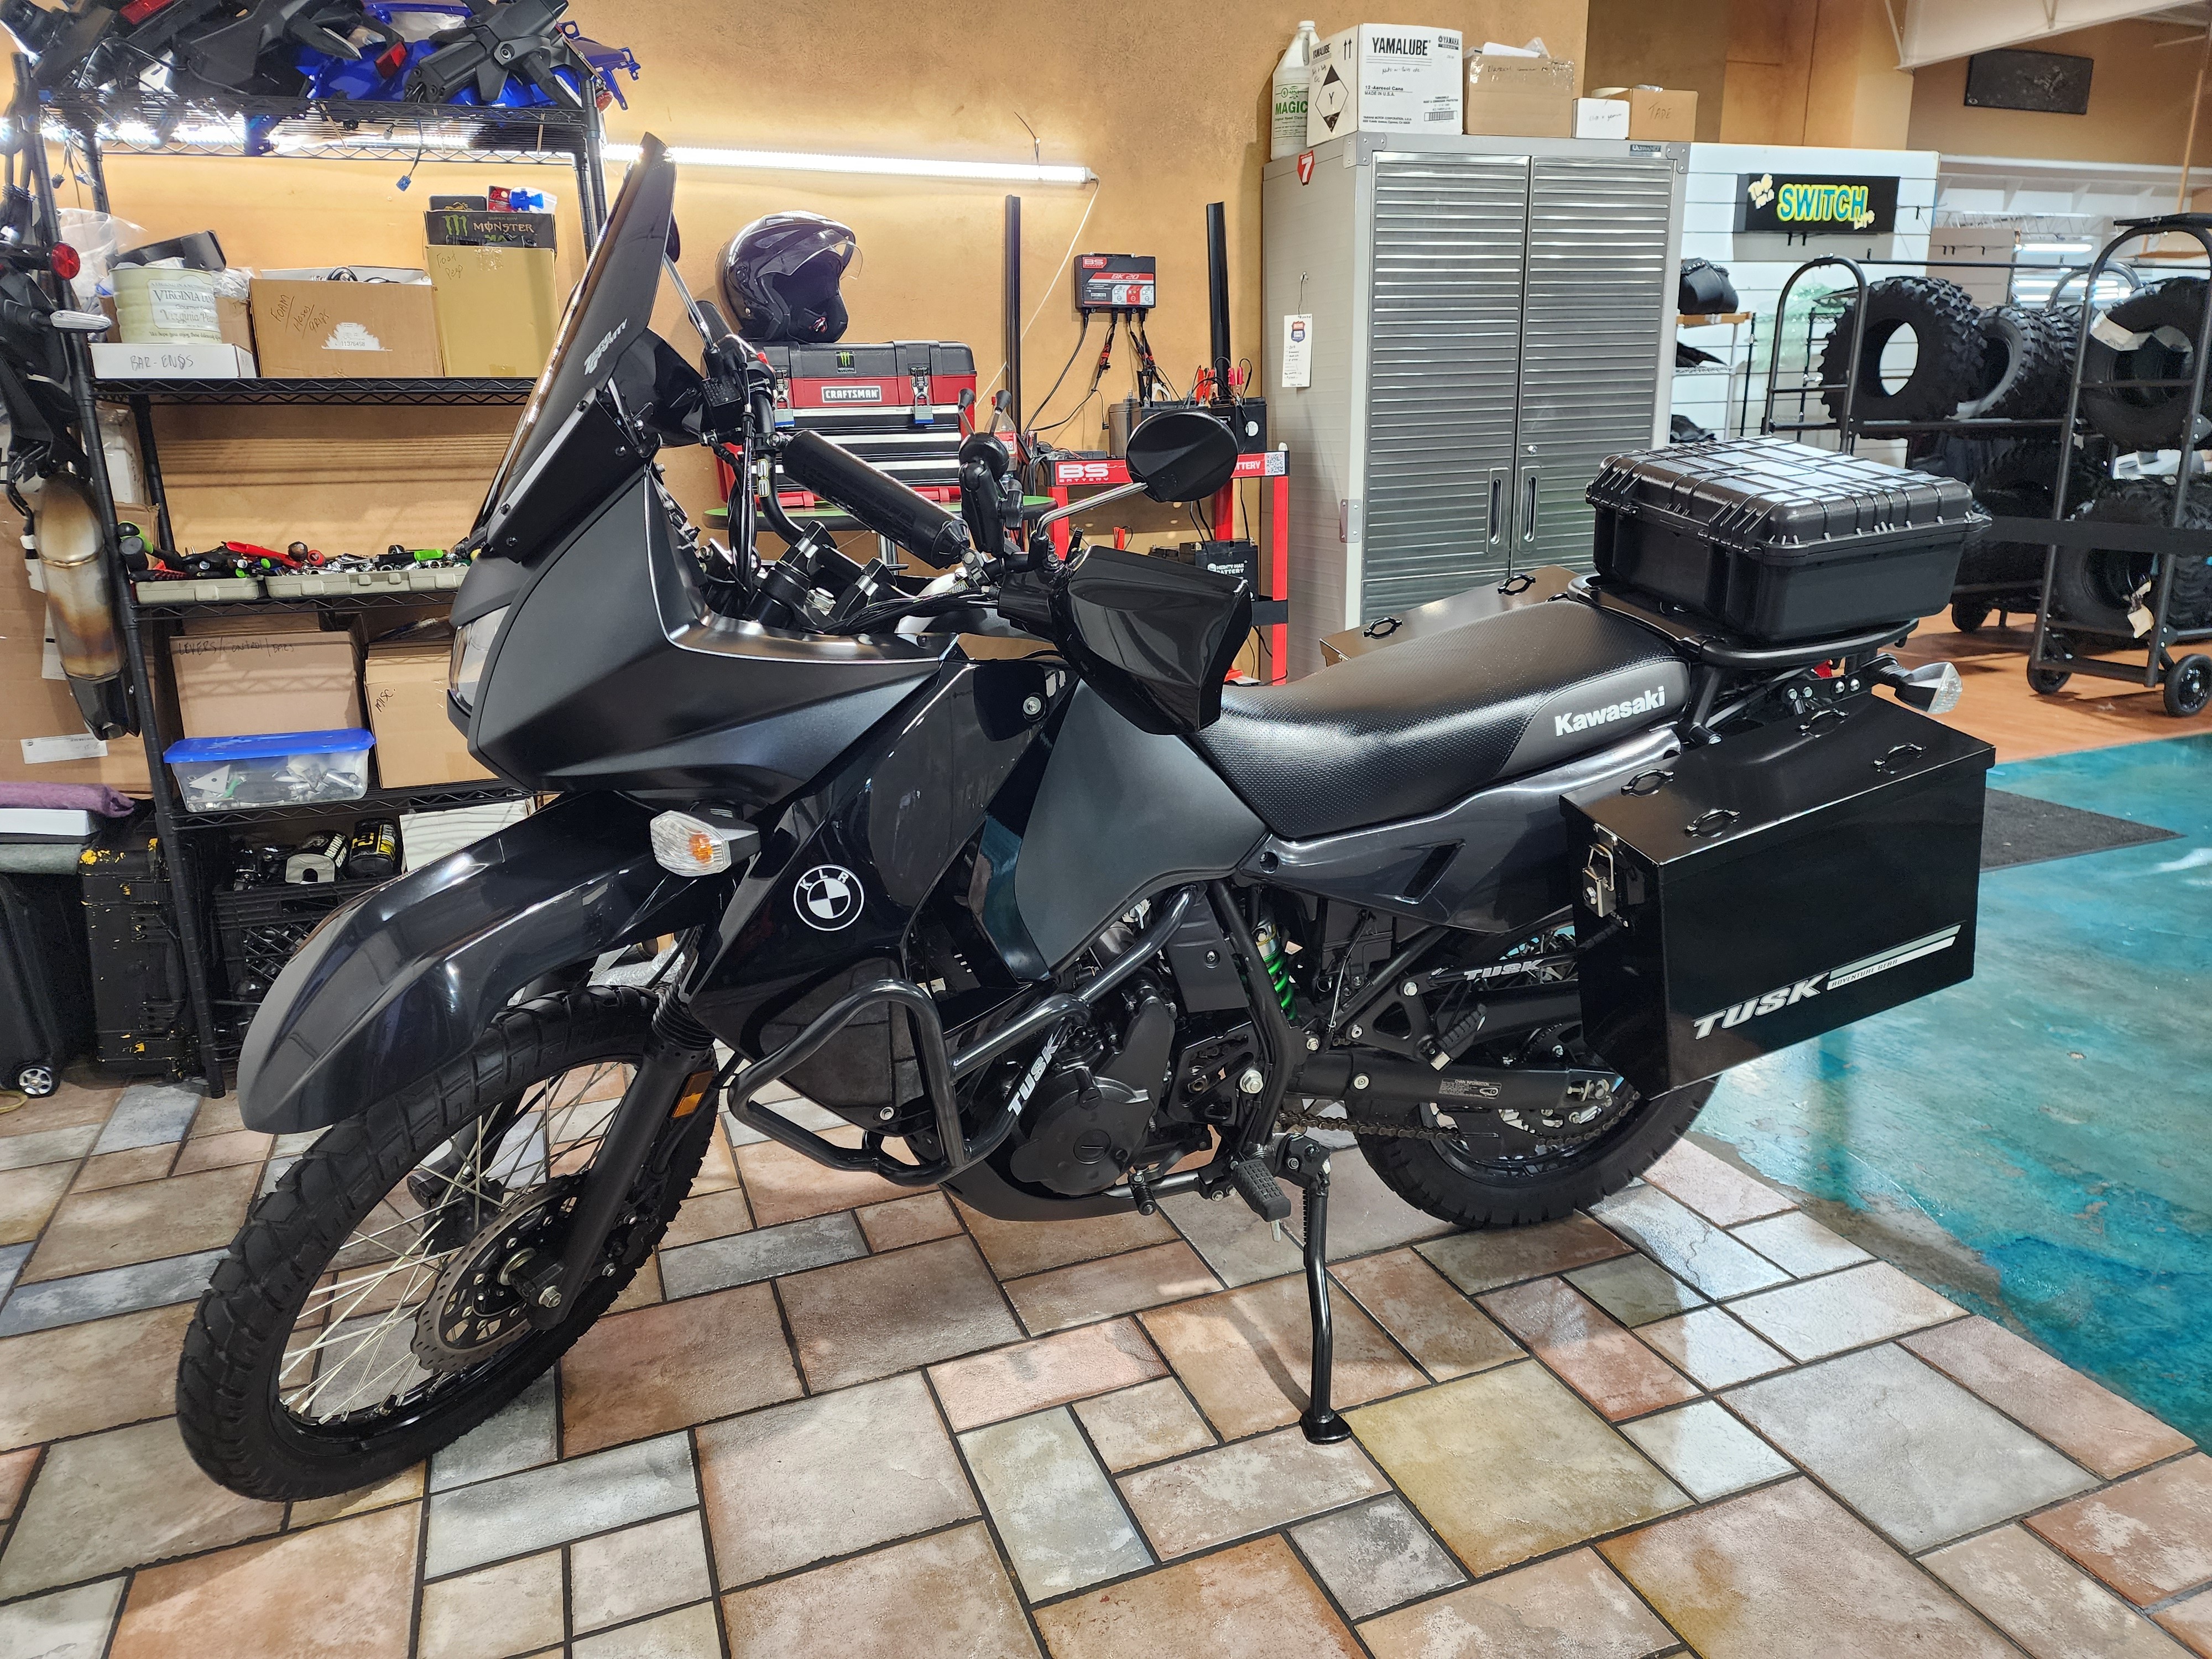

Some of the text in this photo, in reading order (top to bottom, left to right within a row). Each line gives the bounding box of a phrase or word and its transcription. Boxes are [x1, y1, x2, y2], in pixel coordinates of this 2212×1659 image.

[1372, 37, 1428, 56] YAMALUBE
[1275, 100, 1308, 115] MAGIC
[1328, 92, 1334, 105] Y
[1647, 101, 1672, 120] TAPE
[1301, 155, 1313, 183] 7
[1777, 183, 1869, 222] SWITCH
[473, 221, 535, 233] MONSTER
[153, 290, 201, 302] VIRGINIA
[160, 309, 200, 324] Virginia
[270, 294, 290, 322] FOAM
[825, 389, 879, 399] CRAFTSMAN
[1058, 463, 1109, 478] BS
[1554, 686, 1666, 737] Kawasaki
[799, 869, 849, 891] KLR
[1464, 958, 1545, 981] TUSK
[1832, 959, 1898, 987] ADVENTURE GEAR
[1693, 971, 1829, 1040] TUSK
[1007, 1033, 1059, 1117] TUSK
